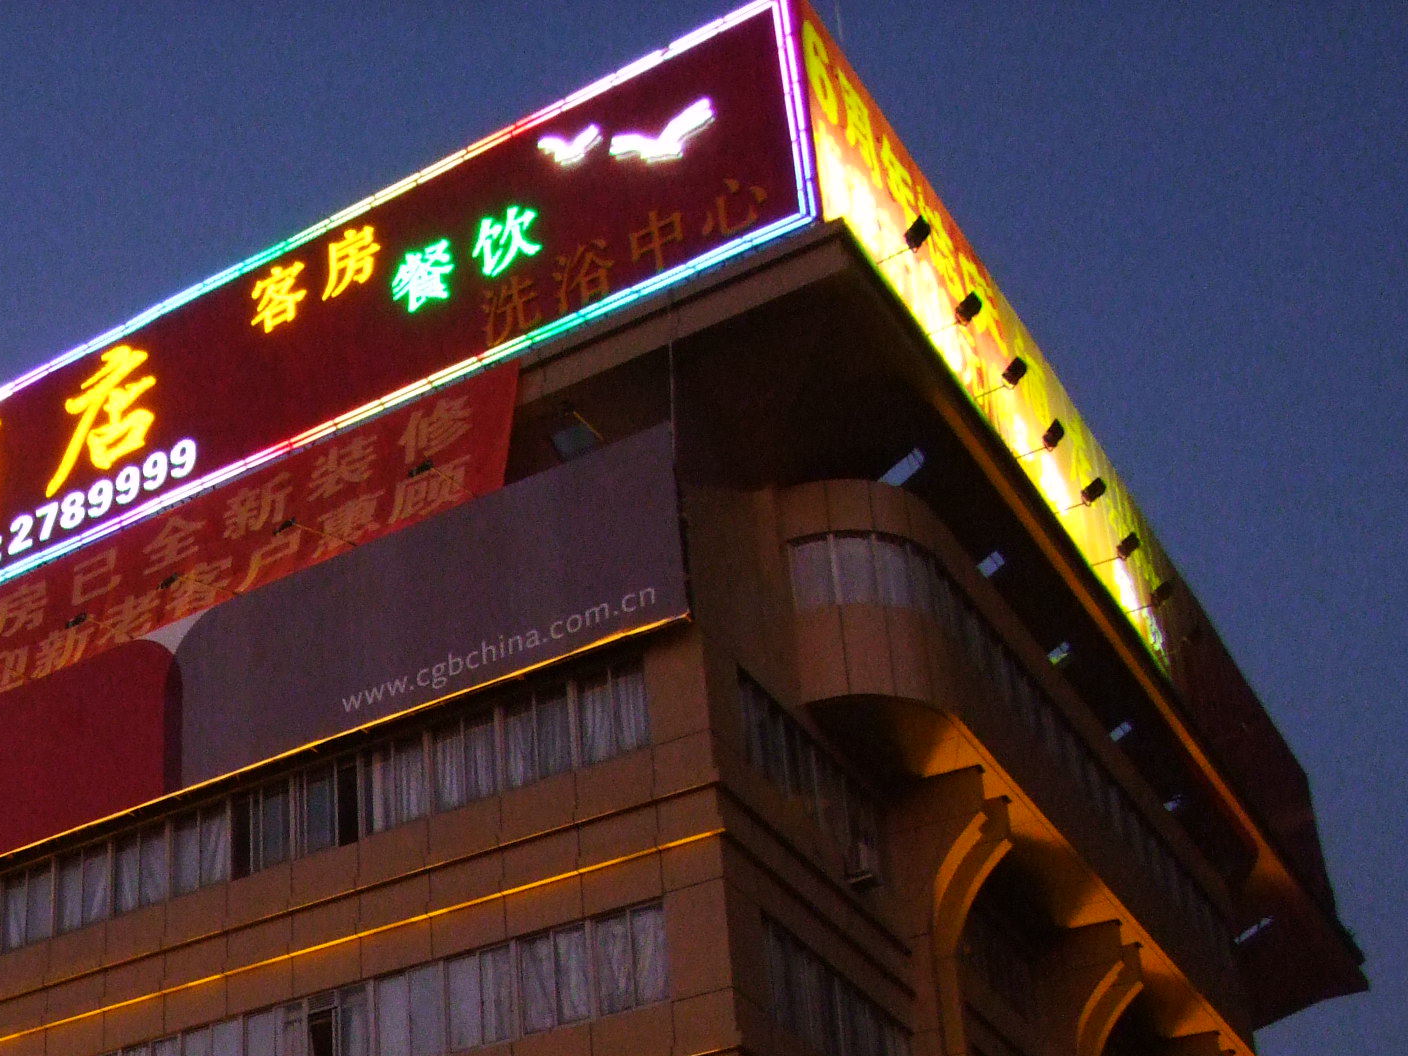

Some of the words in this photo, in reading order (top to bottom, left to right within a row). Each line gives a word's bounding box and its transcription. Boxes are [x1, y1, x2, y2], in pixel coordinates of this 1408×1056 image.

[250, 225, 381, 334] 客房
[391, 205, 543, 313] 餐饮
[481, 178, 768, 346] 洗浴中心
[342, 586, 657, 713] www.cgbchina.com.cn
